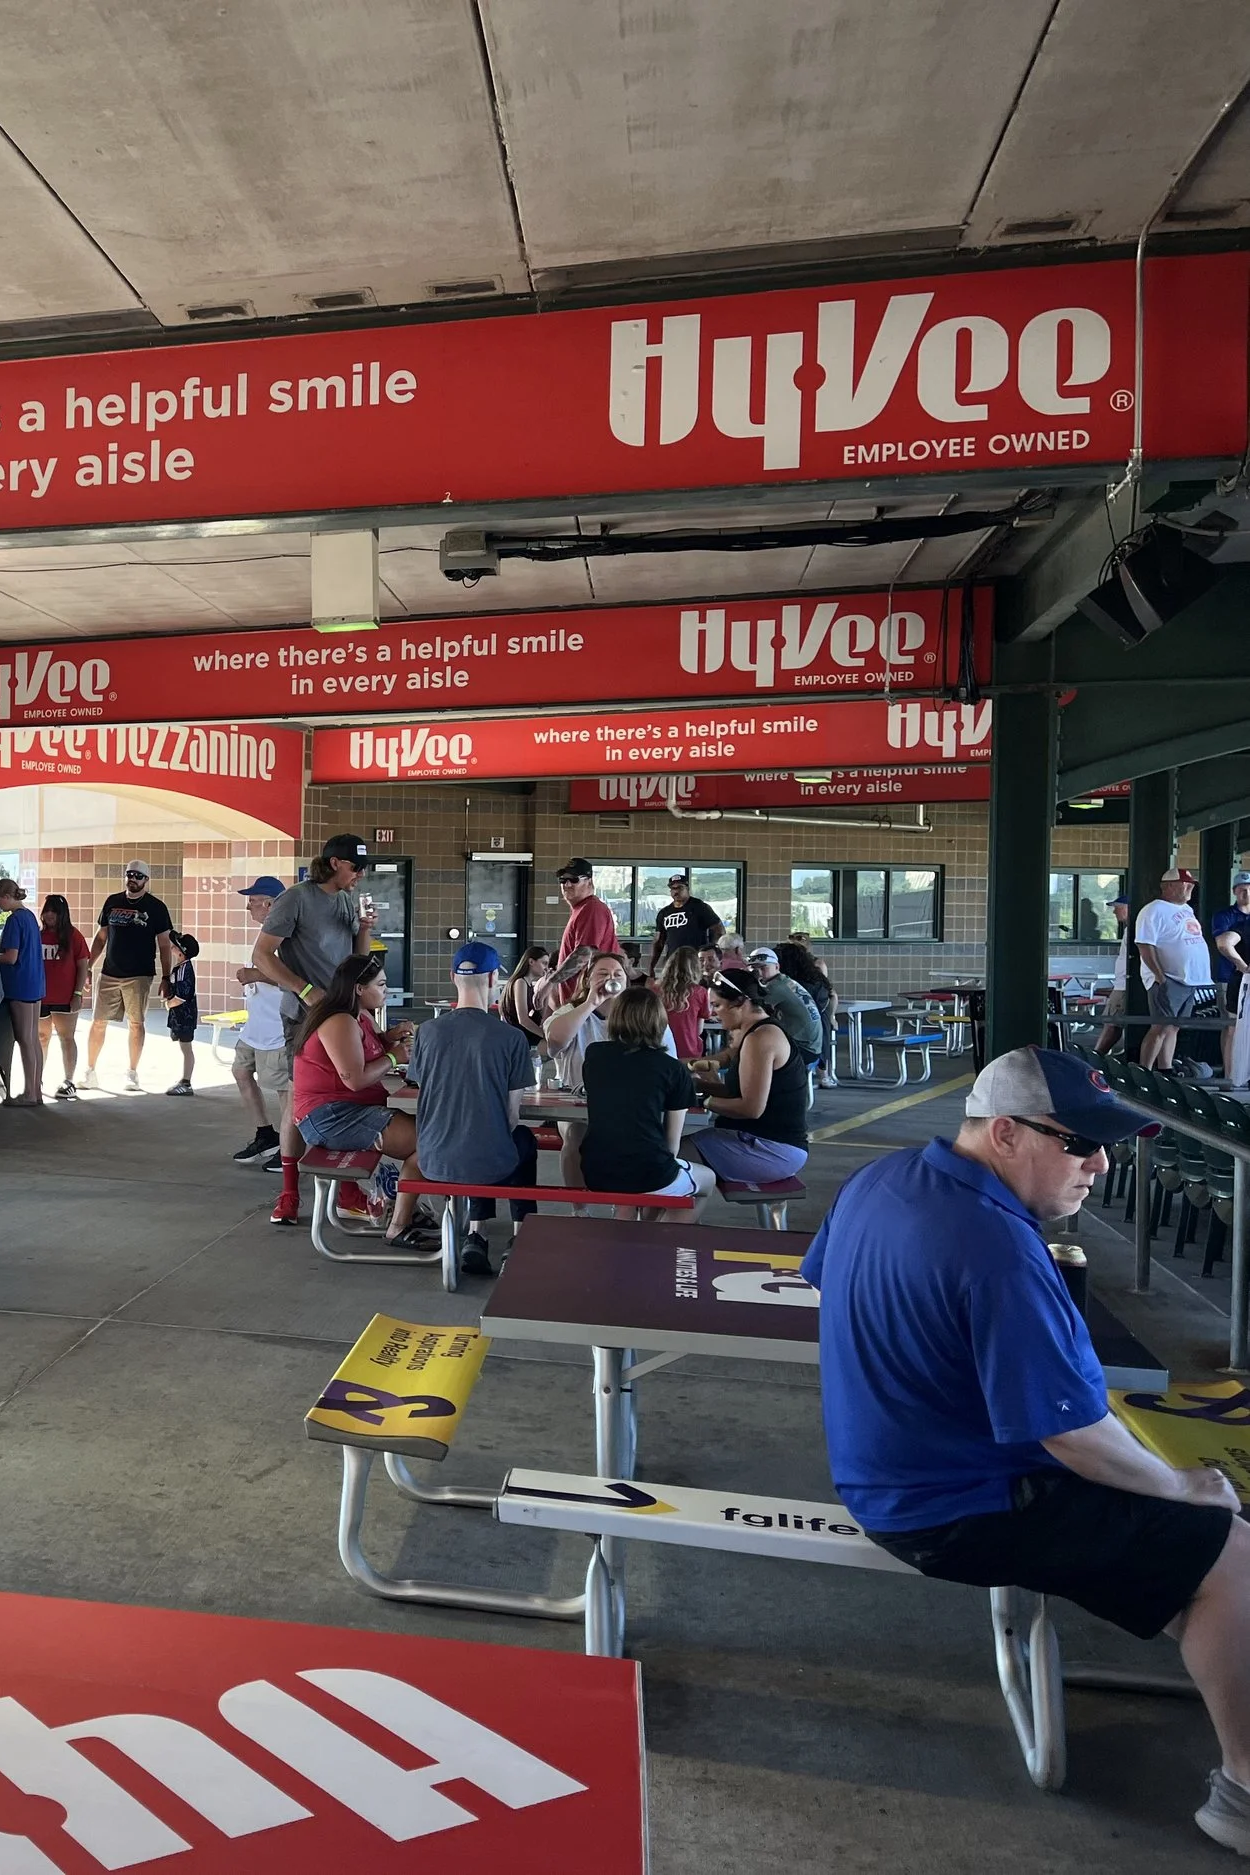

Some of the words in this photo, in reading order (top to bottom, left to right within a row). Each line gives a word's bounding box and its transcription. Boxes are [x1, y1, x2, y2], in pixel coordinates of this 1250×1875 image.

[609, 292, 1111, 470] HyVee
[19, 402, 46, 433] a
[65, 374, 248, 432] helpful
[269, 362, 417, 414] smile
[843, 437, 976, 465] EMPLOYEE
[989, 429, 1090, 455] OWNED
[75, 440, 195, 487] aisle
[193, 650, 270, 671] where
[377, 646, 391, 662] a
[401, 633, 497, 662] helpful
[507, 629, 584, 655] smile
[680, 602, 925, 687] HyVee
[291, 674, 313, 695] in
[322, 672, 397, 695] every
[406, 667, 469, 690] aisle
[794, 674, 859, 686] EMPLOYEE
[865, 671, 914, 683] OWNED
[24, 709, 67, 719] EMPLOYEE
[70, 707, 103, 717] OWNED
[534, 728, 590, 744] where
[668, 726, 679, 738] a
[685, 718, 755, 739] helpful
[762, 716, 818, 734] smile
[887, 699, 992, 757] HyV
[350, 728, 472, 777] HyVee
[606, 745, 622, 761] in
[628, 745, 683, 762] every
[689, 741, 735, 758] aisle
[21, 760, 55, 772] EMPLOYEE
[57, 763, 82, 775] OWNED
[408, 768, 440, 776] EMPLOYEE
[744, 771, 788, 782] where
[800, 783, 814, 795] in
[819, 783, 861, 796] every
[866, 780, 902, 793] aisle
[376, 829, 394, 843] EXIT
[676, 1247, 698, 1279] ANNUITIES
[675, 1284, 698, 1299] LIFE
[390, 1327, 417, 1345] into
[441, 1333, 479, 1358] Turning
[370, 1341, 409, 1368] Reality
[406, 1332, 447, 1371] Aspirations
